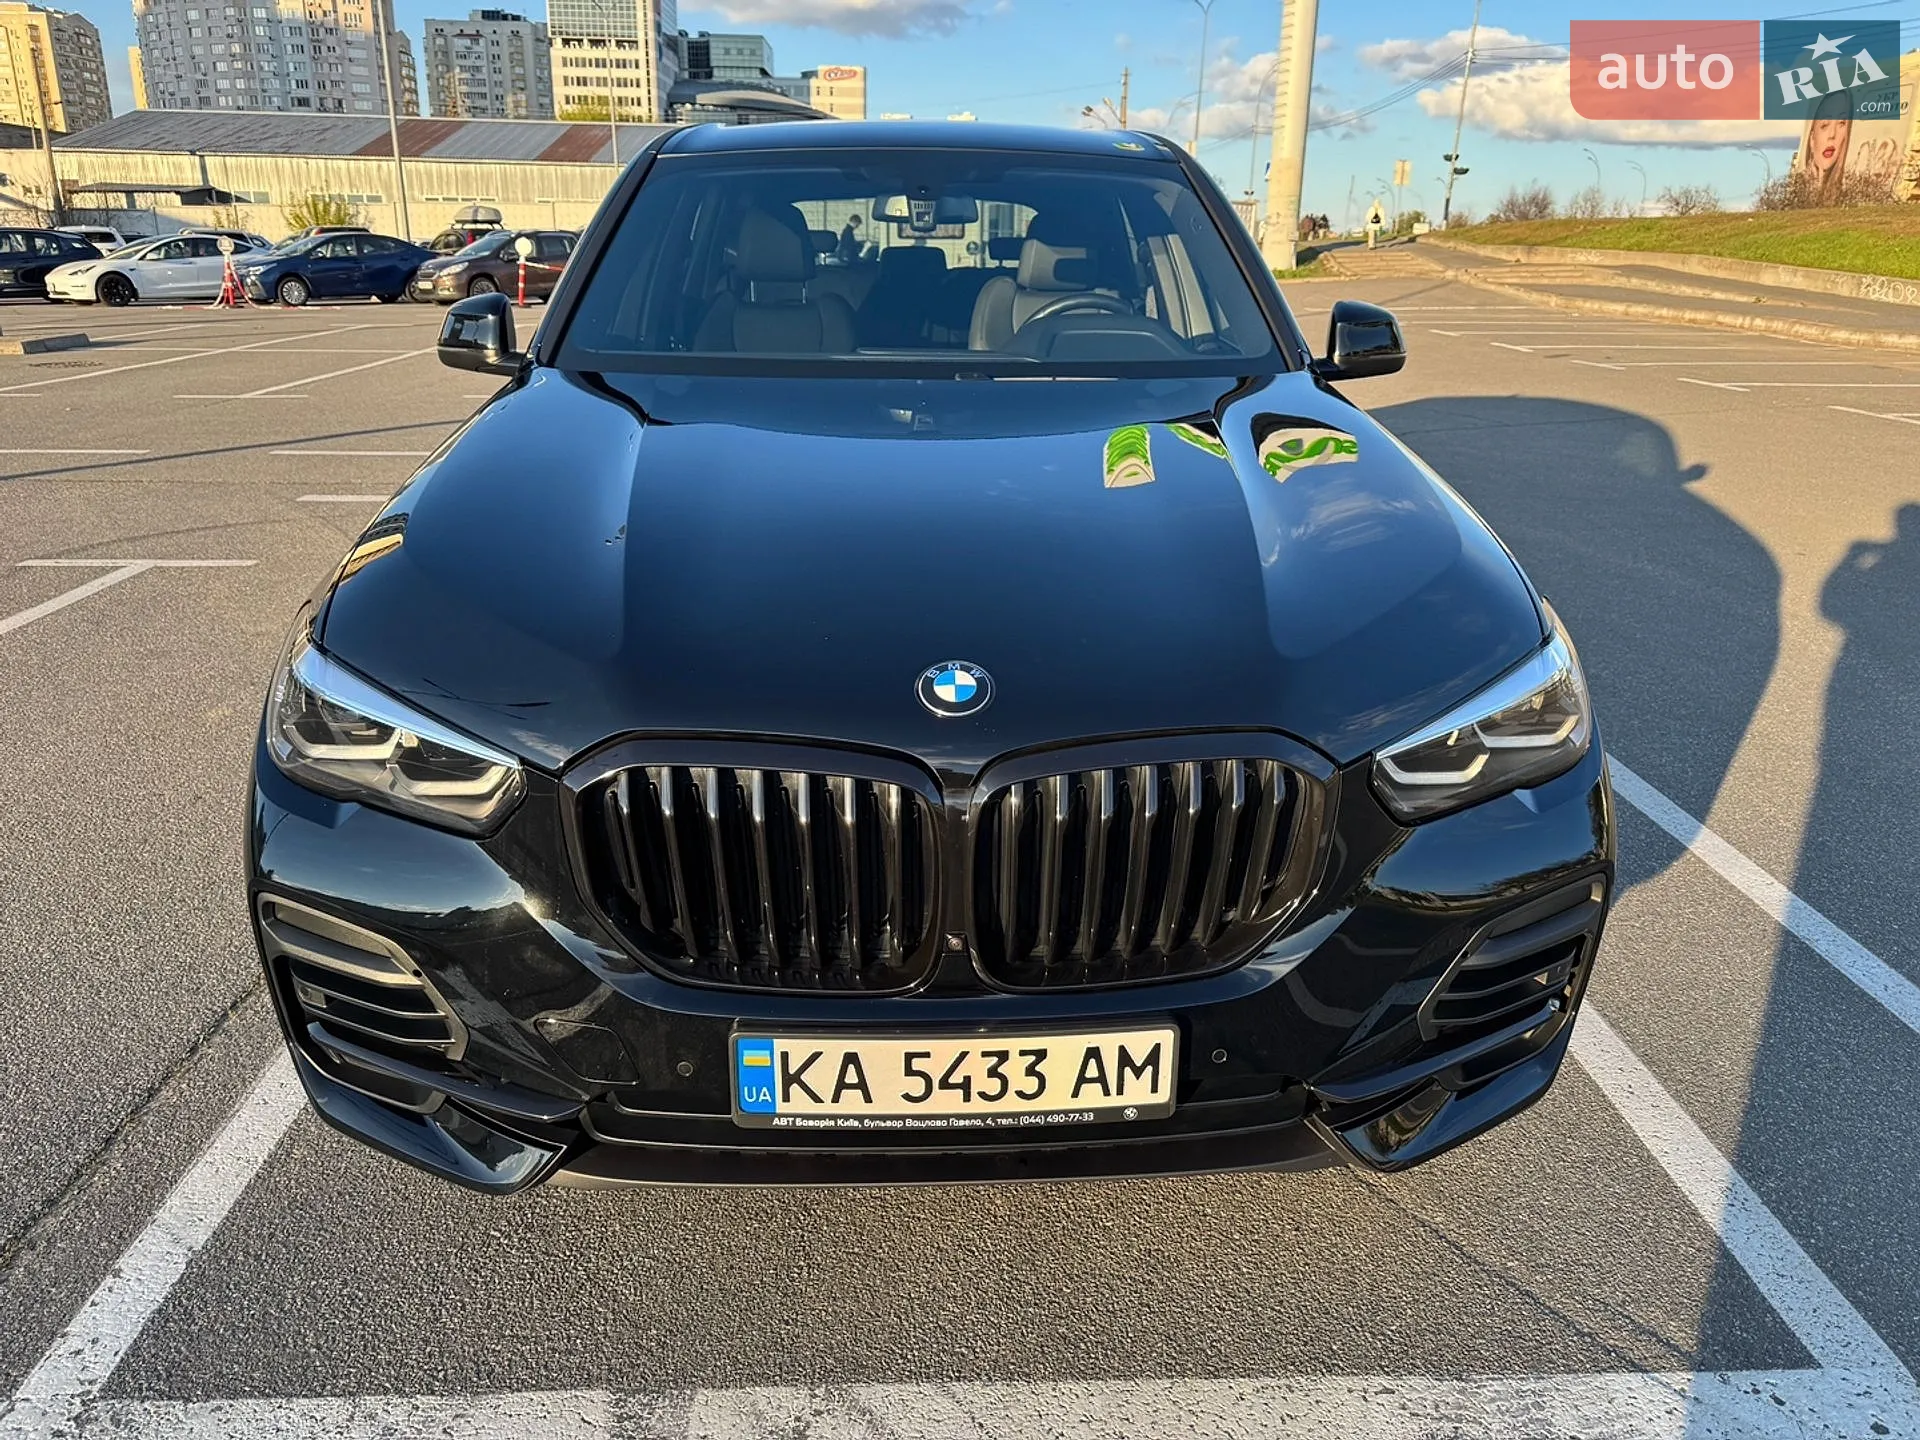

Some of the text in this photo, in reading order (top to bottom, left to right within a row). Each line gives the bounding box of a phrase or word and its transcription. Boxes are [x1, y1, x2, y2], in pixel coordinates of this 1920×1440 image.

[926, 663, 983, 678] BMW
[780, 1042, 1161, 1104] KA 5433 AM
[744, 1086, 771, 1102] UA
[772, 1117, 794, 1125] АВТ
[863, 1118, 904, 1128] бульвар
[986, 1117, 995, 1126] 4,
[1019, 1114, 1045, 1125] (044)
[1046, 1112, 1094, 1122] 490-77-33
